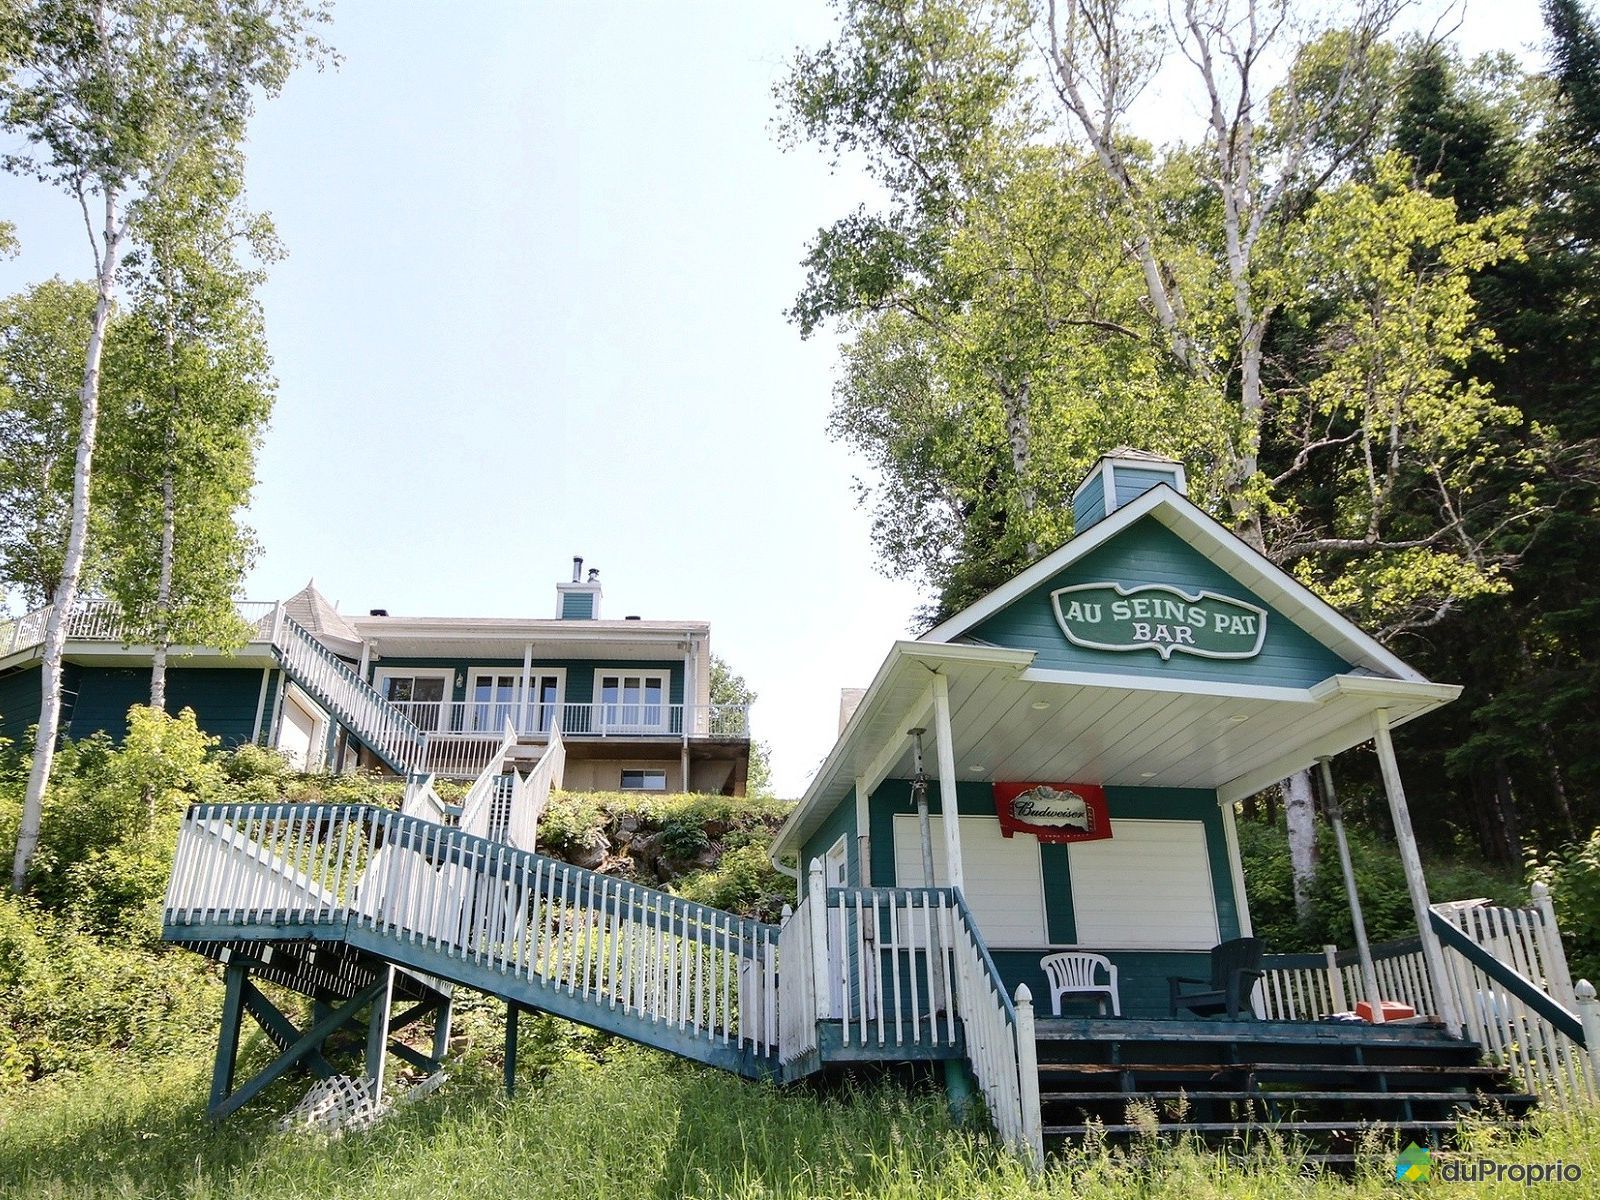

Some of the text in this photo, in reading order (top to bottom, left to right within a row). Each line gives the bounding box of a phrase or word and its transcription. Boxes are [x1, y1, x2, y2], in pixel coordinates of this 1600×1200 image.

[1065, 599, 1256, 635] AU SEINS PAT
[1132, 622, 1196, 644] BAR
[1015, 801, 1085, 819] Budweiser
